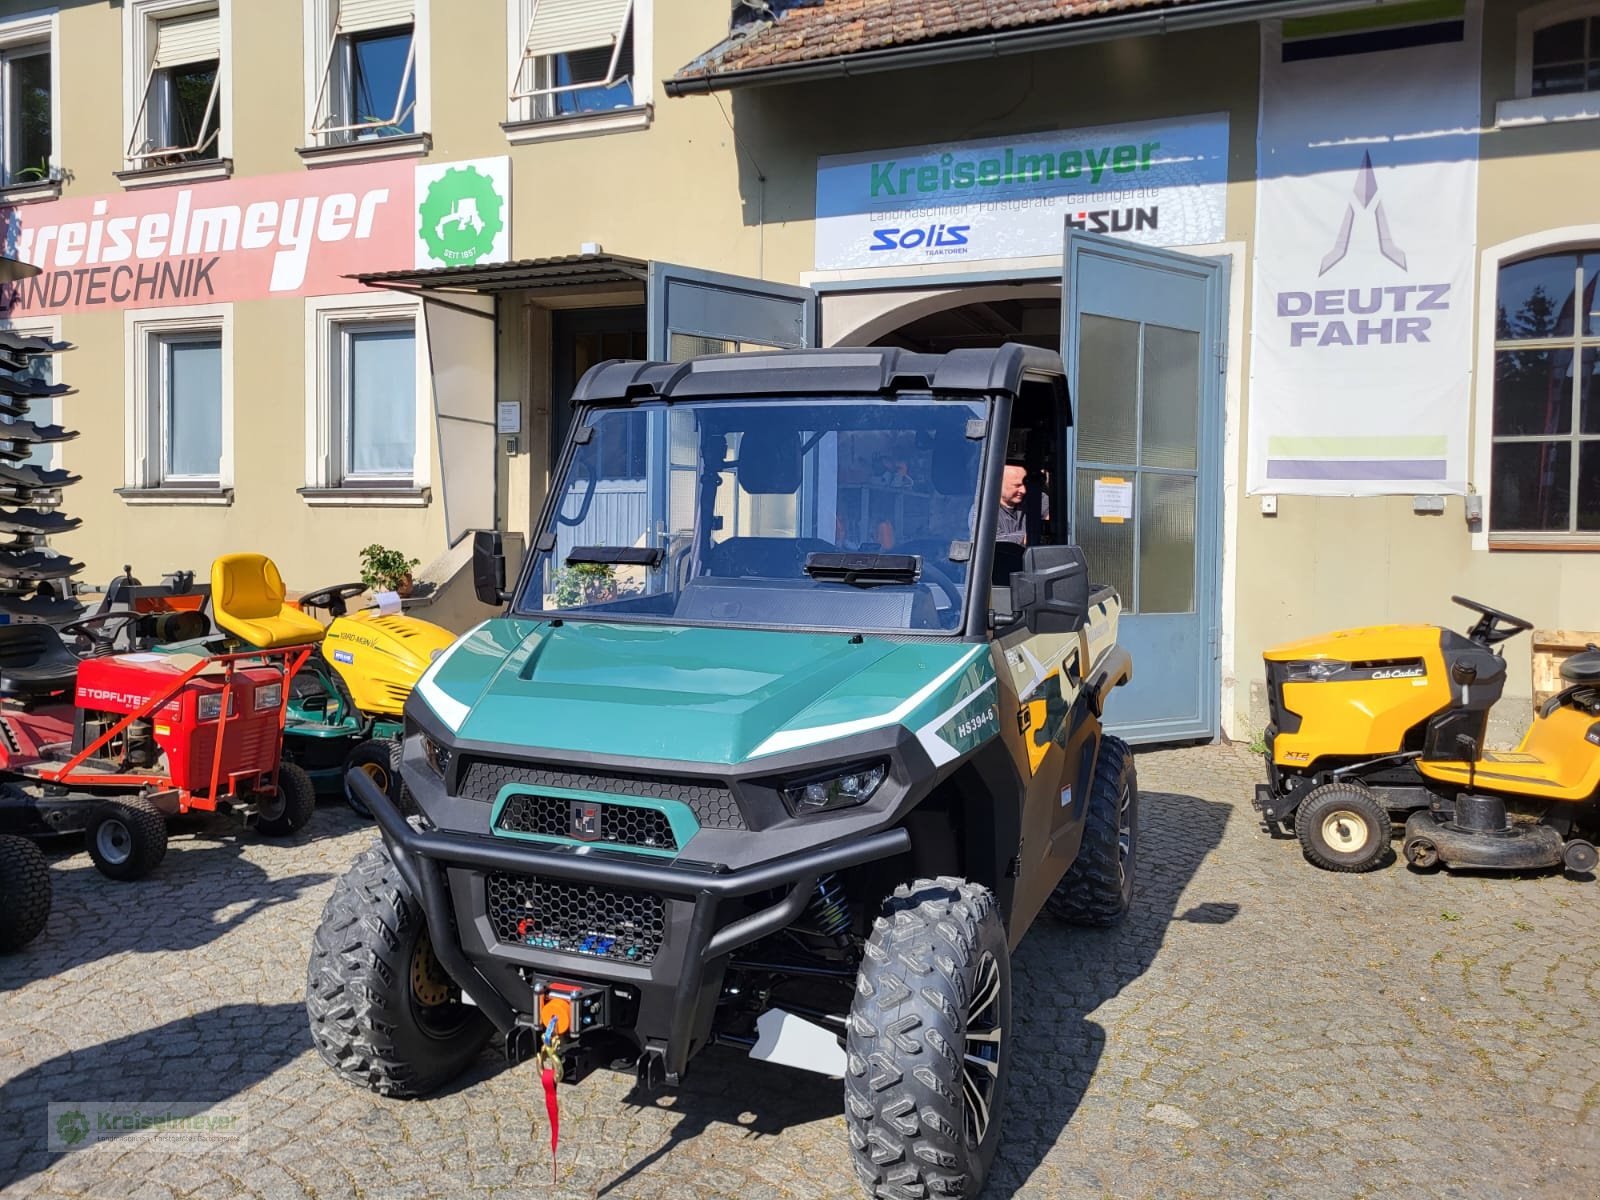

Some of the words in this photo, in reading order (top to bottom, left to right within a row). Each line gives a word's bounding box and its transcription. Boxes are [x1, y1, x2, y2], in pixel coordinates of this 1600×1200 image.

[870, 141, 1161, 197] Kreiselmeyer
[1277, 283, 1451, 317] DEUTZ
[1290, 316, 1432, 347] FAHR
[1371, 670, 1391, 679] Cub
[1391, 668, 1423, 678] Cadet
[87, 688, 142, 705] TOPFLITE
[958, 708, 994, 738] HS394-6
